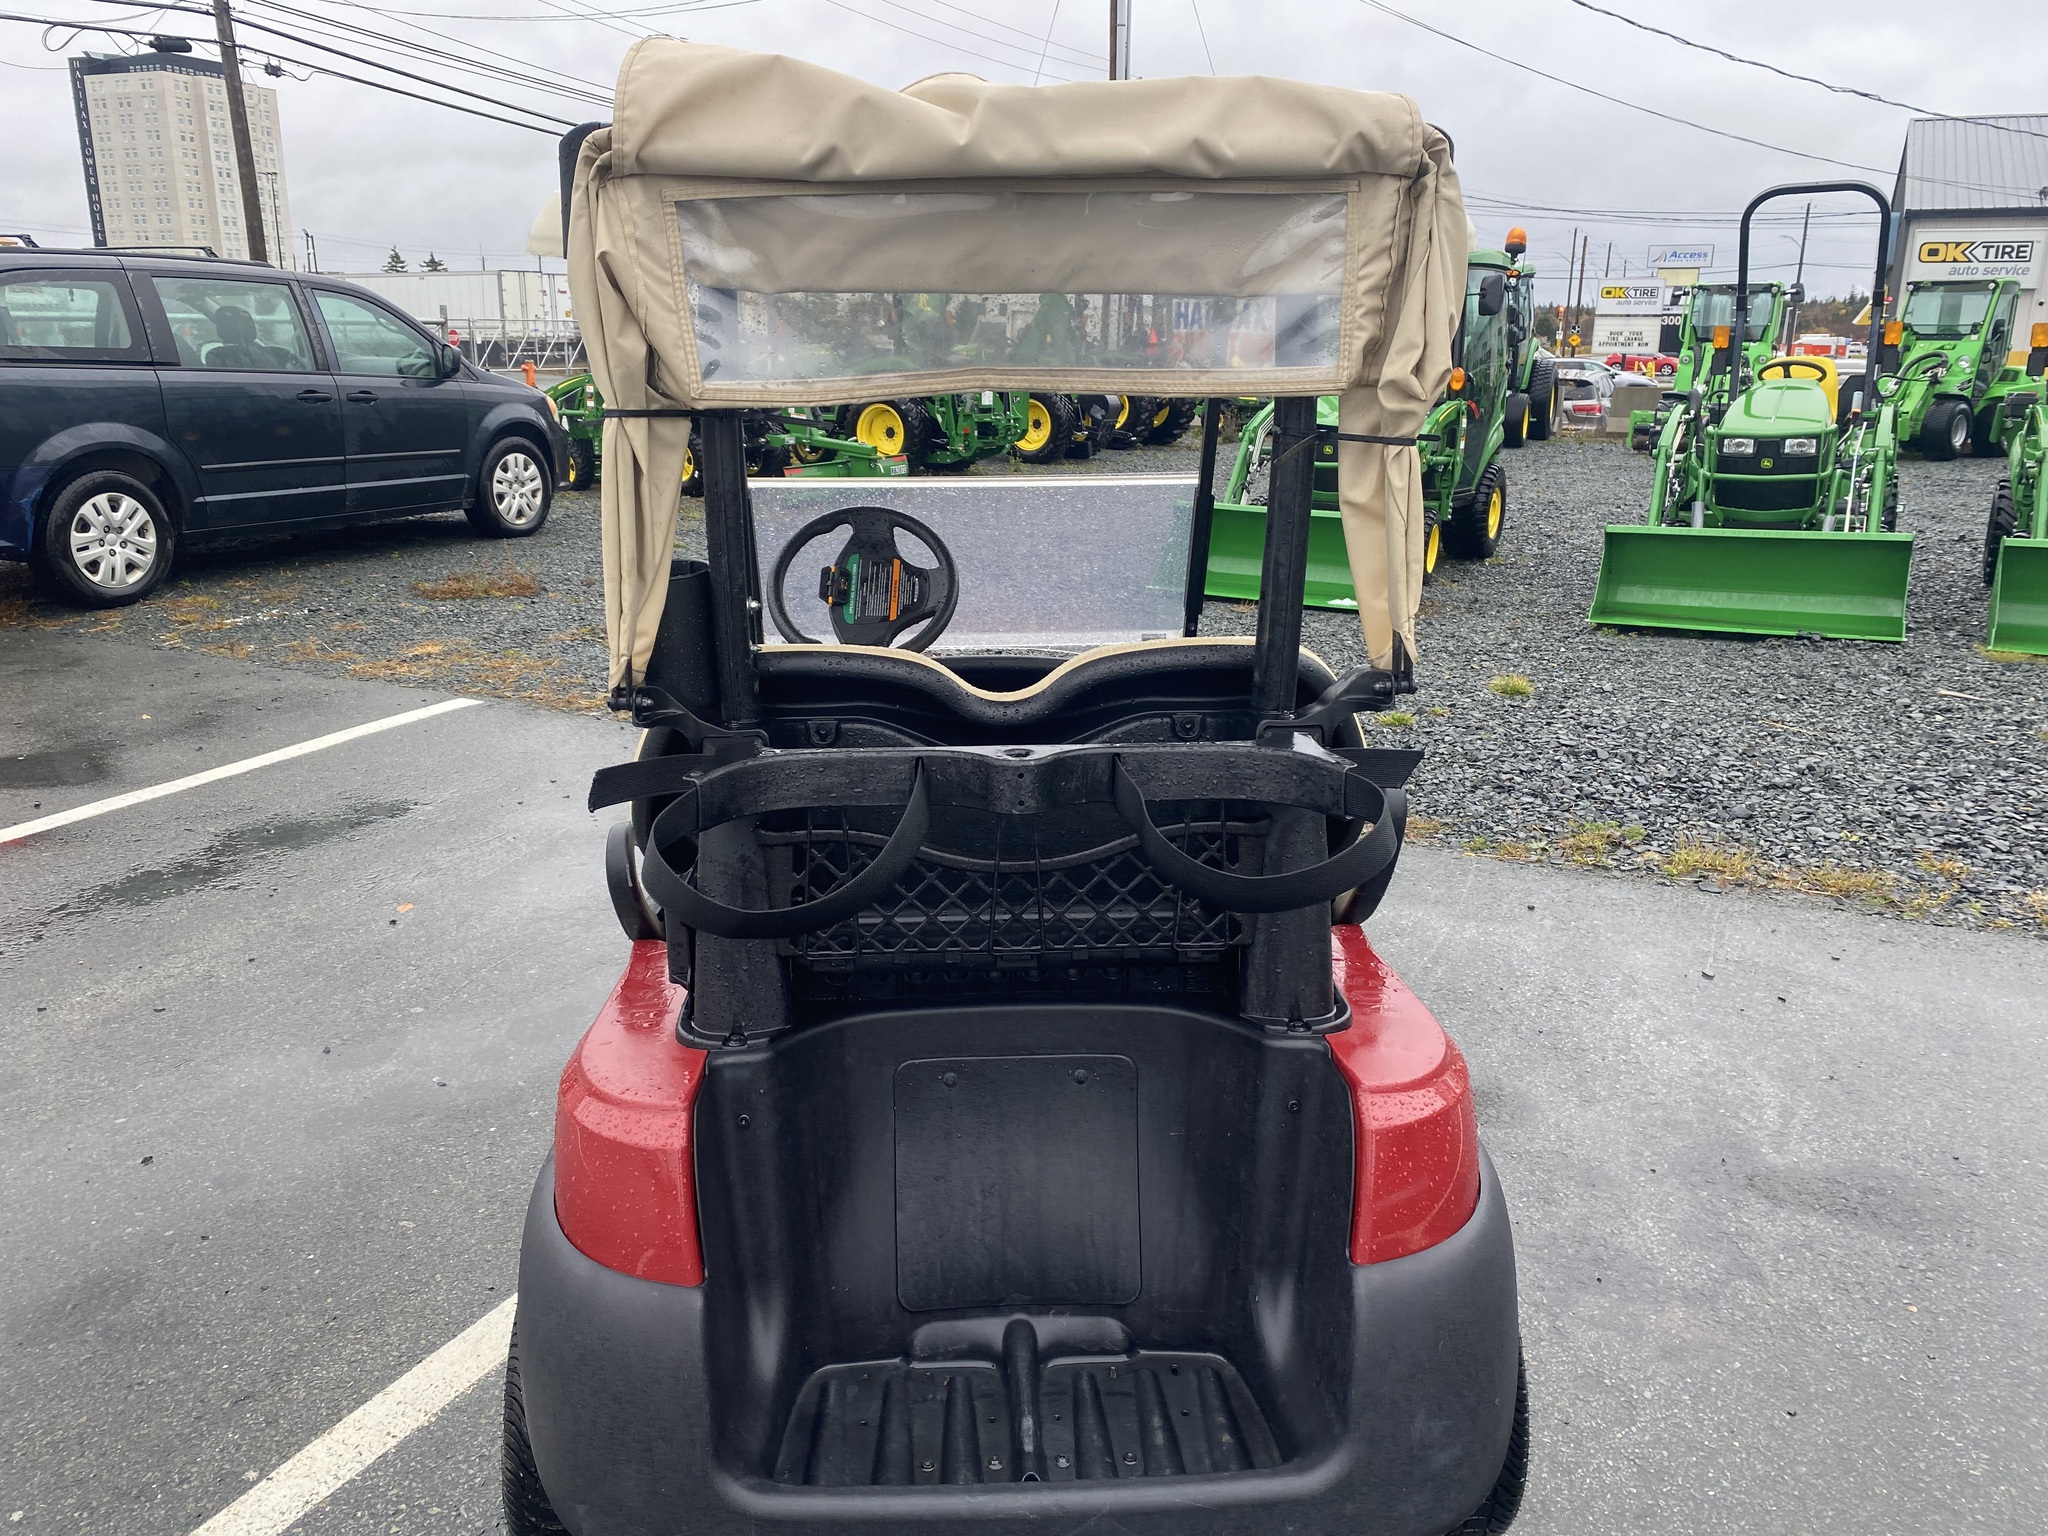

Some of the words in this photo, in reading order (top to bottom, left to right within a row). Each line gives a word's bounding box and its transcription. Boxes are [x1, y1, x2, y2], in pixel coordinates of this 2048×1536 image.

[73, 60, 88, 129] HALIFAX
[84, 137, 96, 185] TOWER
[91, 193, 103, 240] HOTEL
[1669, 250, 1709, 259] Access
[1919, 242, 1973, 262] OK
[1981, 244, 2030, 260] TIRE
[1948, 265, 1979, 276] auto
[1982, 264, 2031, 276] service
[1601, 287, 1629, 299] OK
[1632, 288, 1657, 297] TIRE
